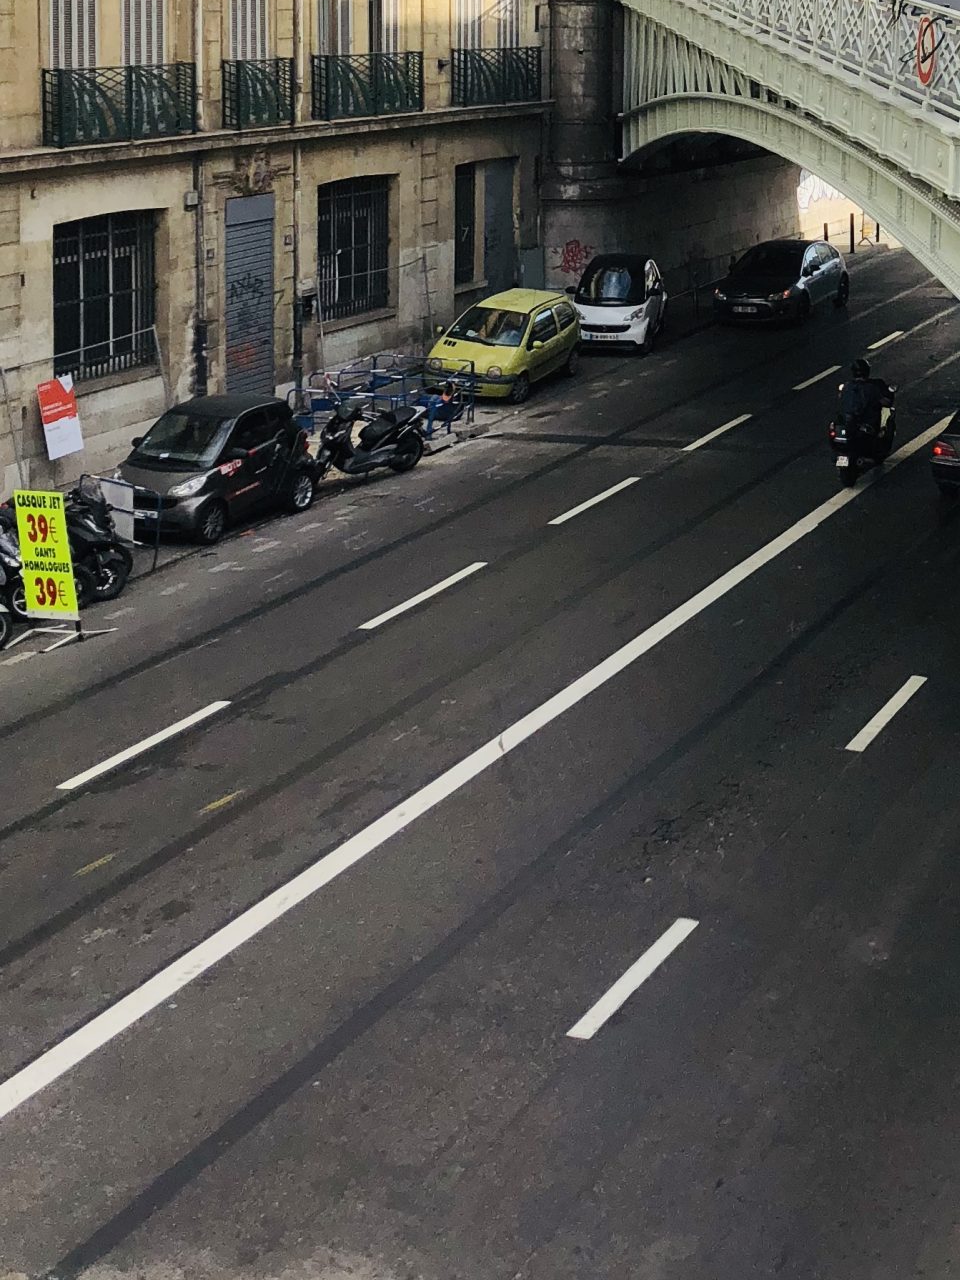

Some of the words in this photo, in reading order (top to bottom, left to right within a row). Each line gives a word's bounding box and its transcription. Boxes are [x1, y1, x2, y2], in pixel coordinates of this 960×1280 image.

[17, 494, 46, 508] CASQUE
[49, 496, 60, 509] JET
[27, 513, 59, 543] 39€
[34, 547, 56, 558] GANTS
[24, 561, 70, 573] HOMOLOGUES
[34, 577, 68, 607] 39€
